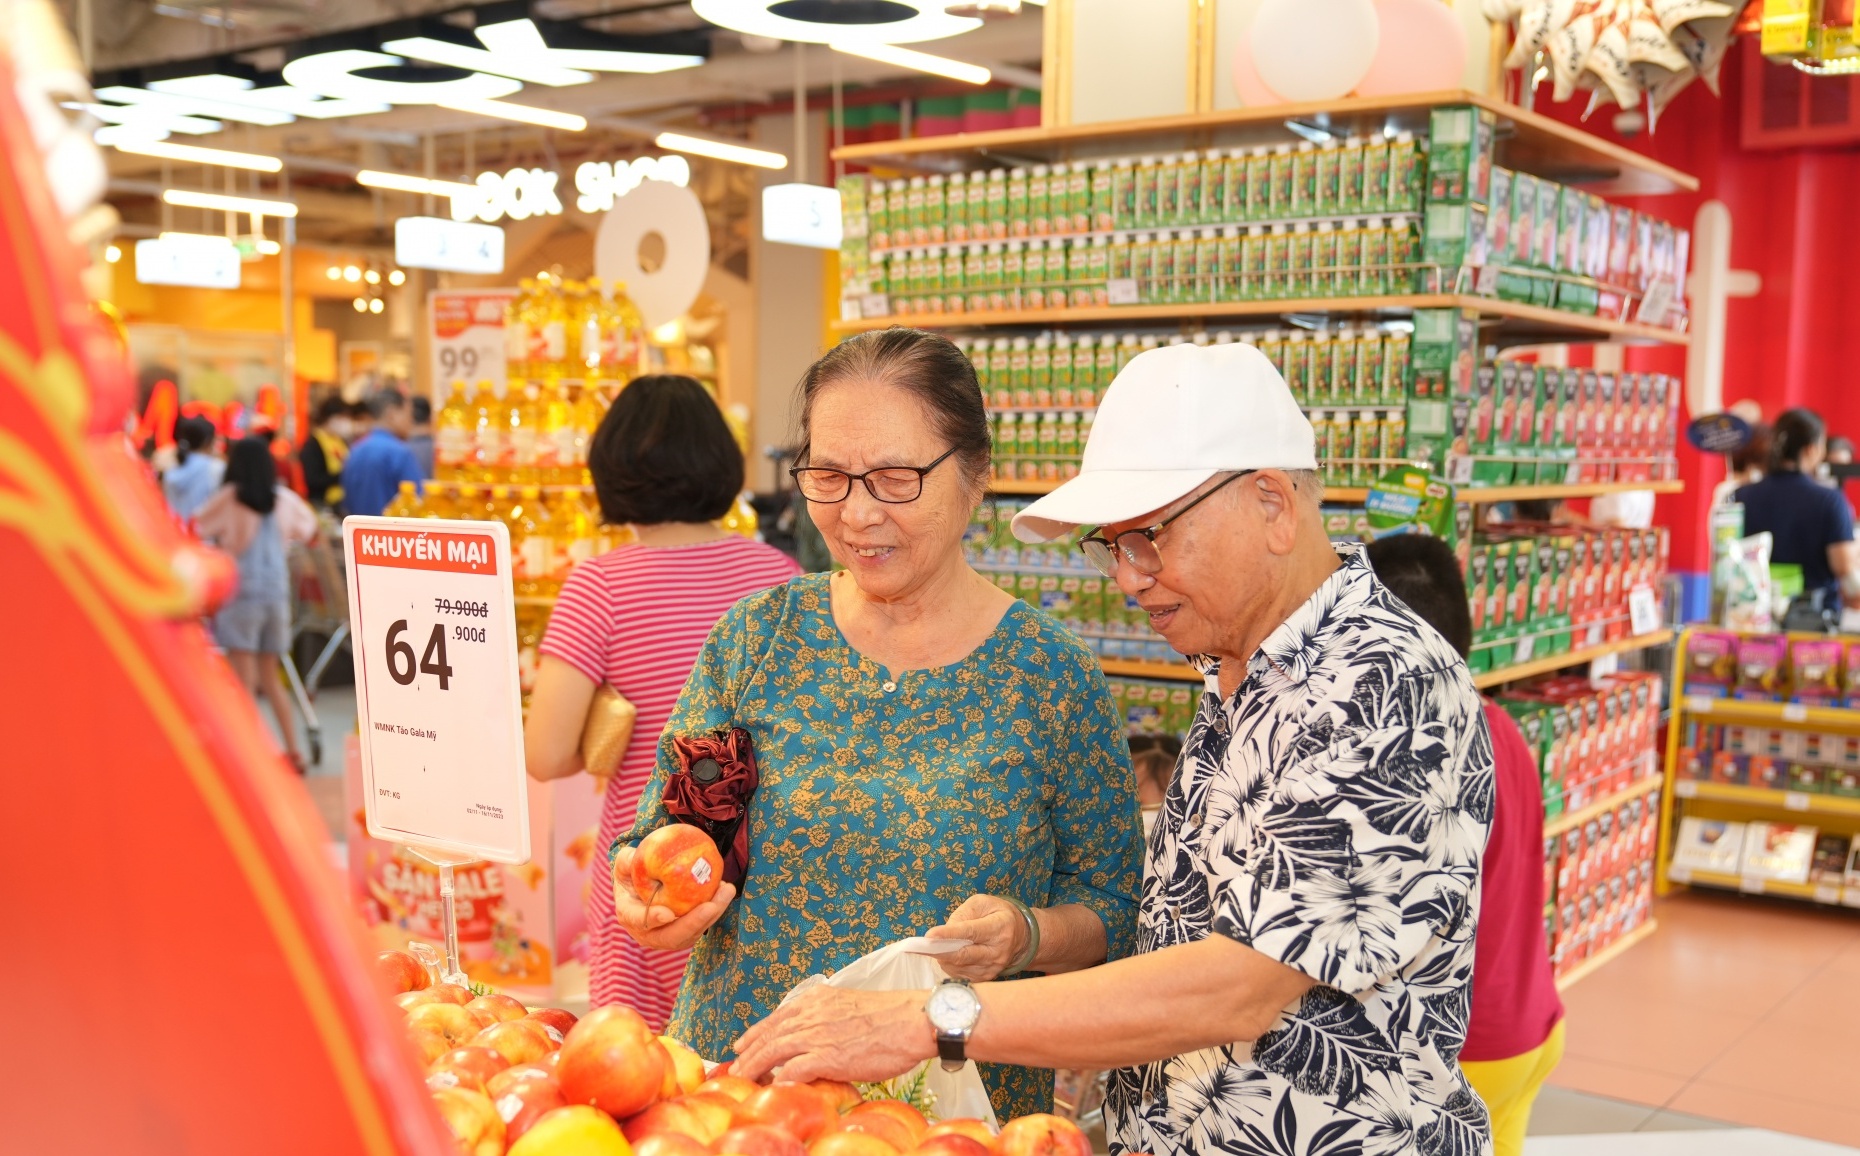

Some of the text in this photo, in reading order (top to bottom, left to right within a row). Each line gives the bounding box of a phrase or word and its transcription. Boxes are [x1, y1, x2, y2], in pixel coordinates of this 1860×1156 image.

[440, 346, 478, 379] 99
[361, 532, 488, 570] KHUYẾN MẠI
[434, 598, 489, 618] 79.900đ
[385, 619, 486, 691] 64 .900đ
[373, 721, 437, 741] WMNK Táo Gala Mỹ
[392, 791, 401, 800] KG
[443, 866, 505, 899] ALE
